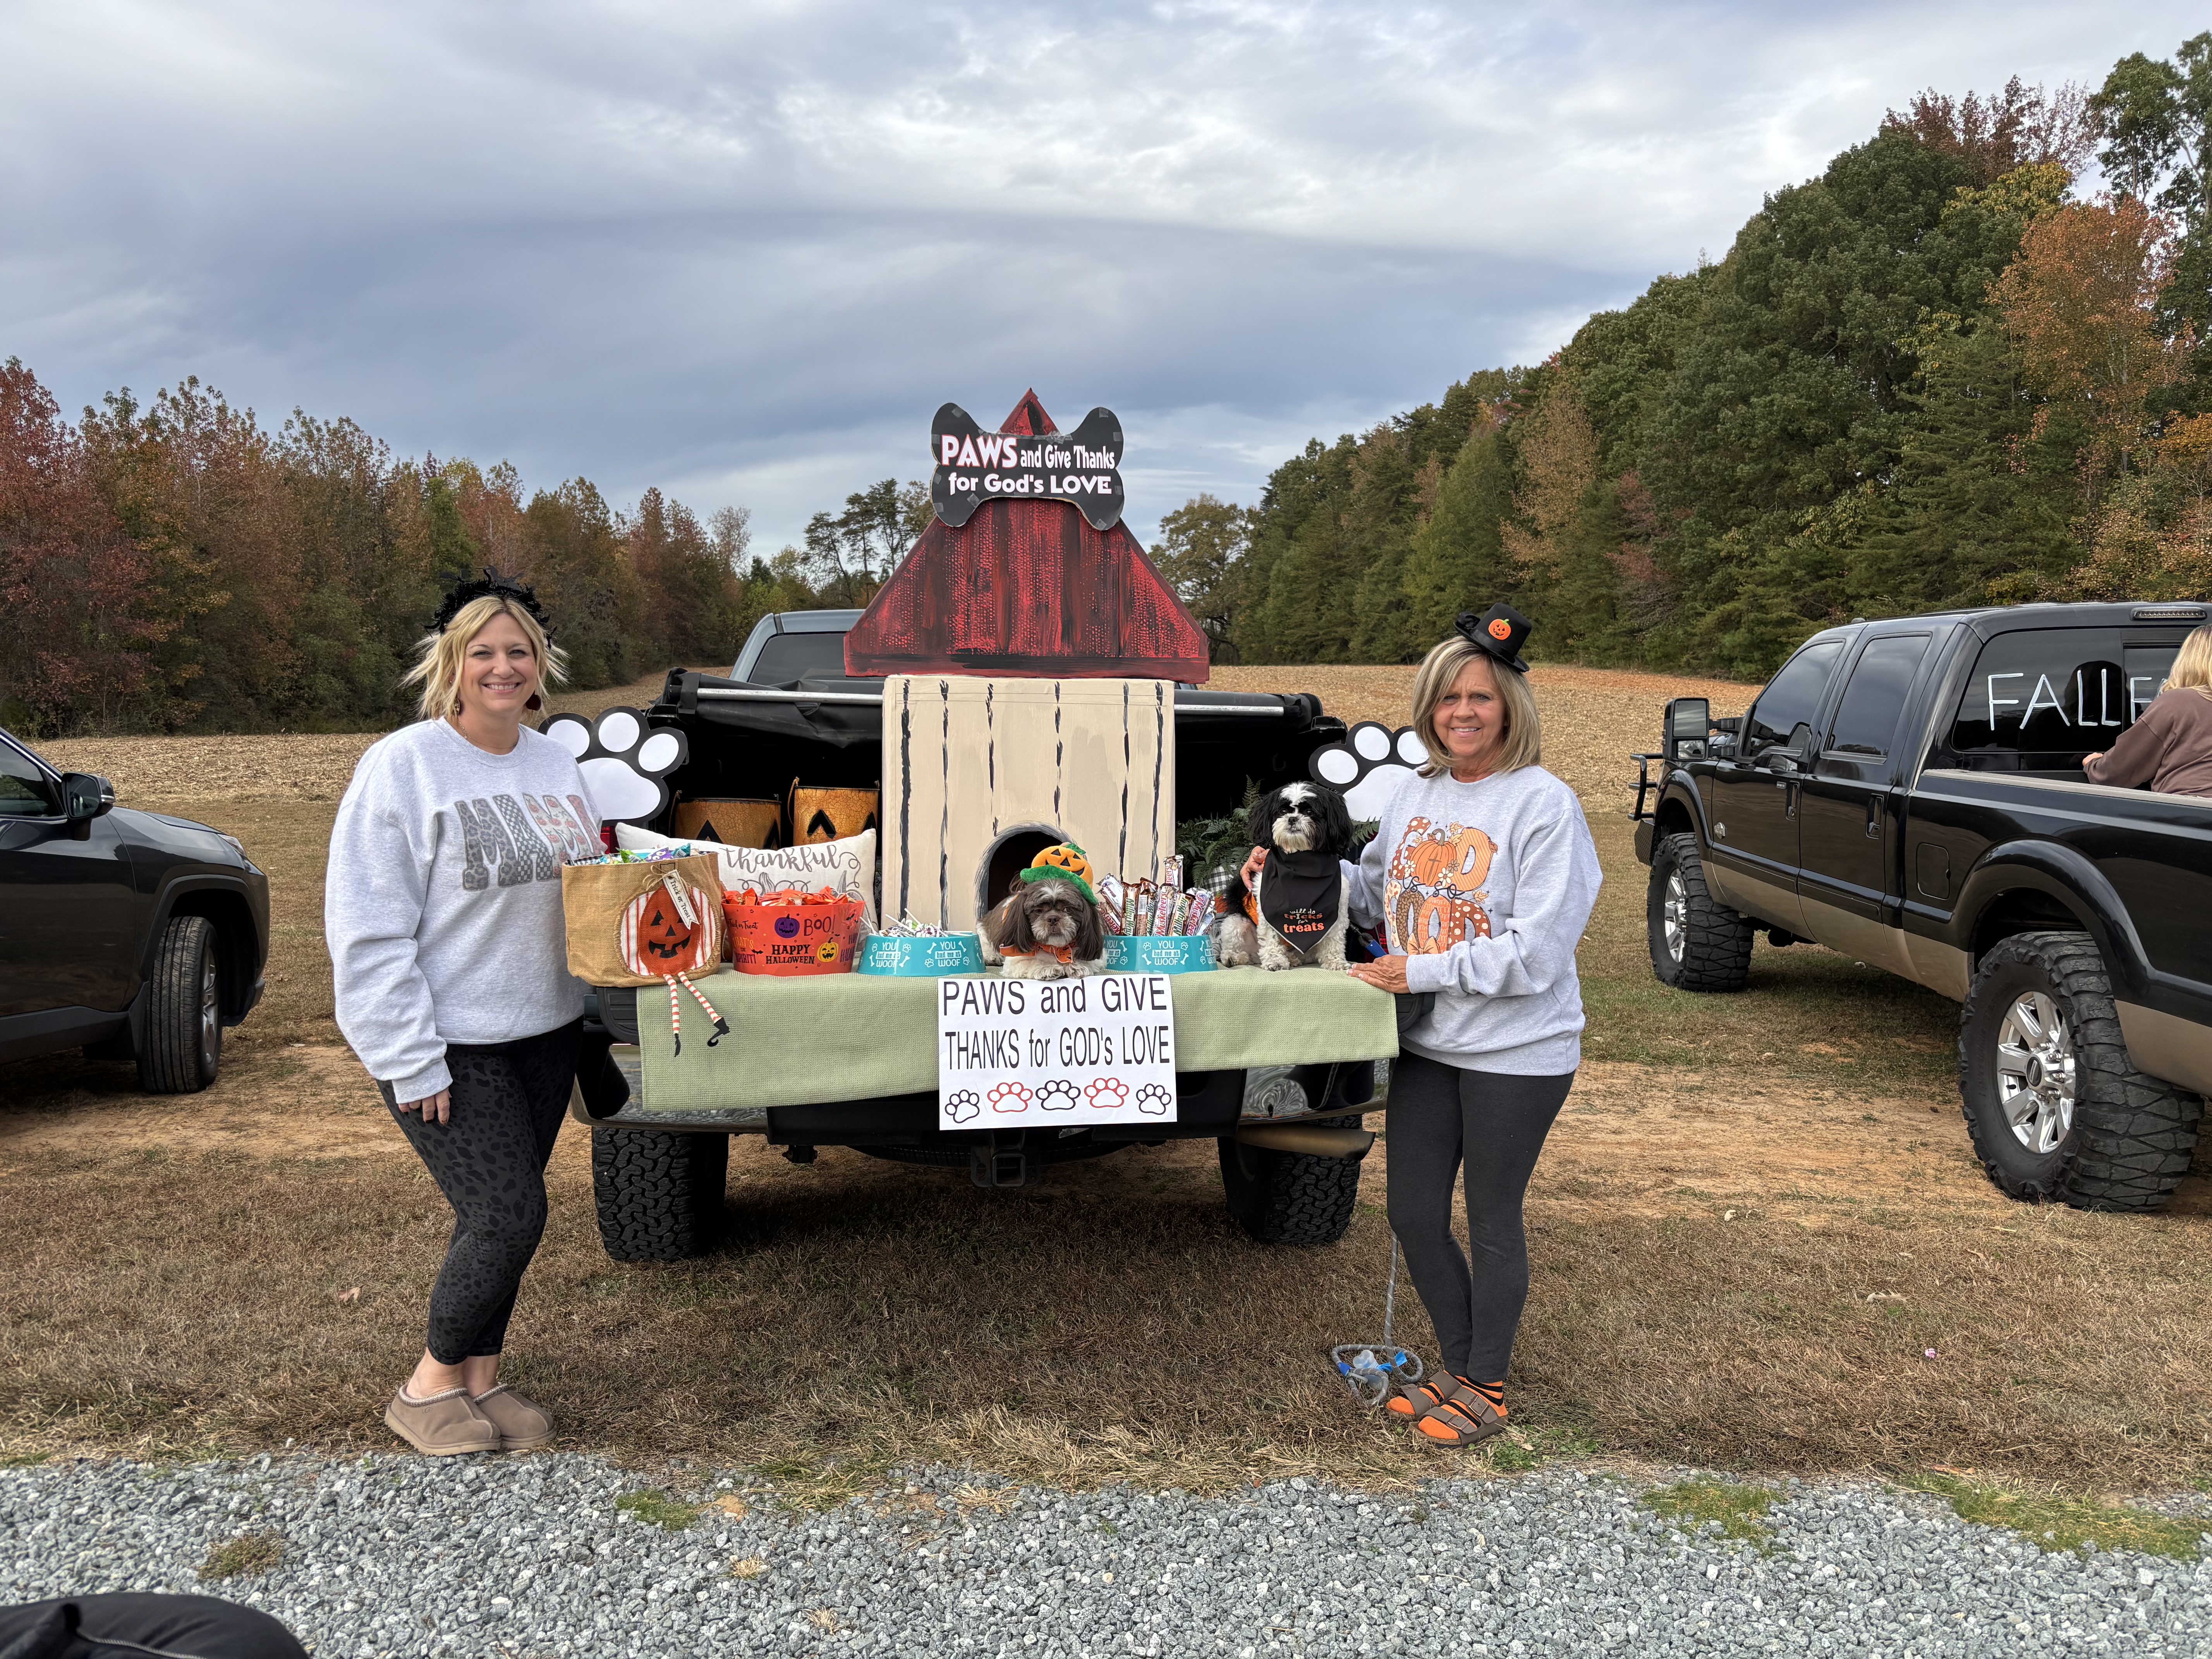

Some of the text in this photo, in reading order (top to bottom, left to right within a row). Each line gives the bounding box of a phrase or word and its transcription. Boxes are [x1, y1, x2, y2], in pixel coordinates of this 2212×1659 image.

[941, 434, 1115, 469] PAWS and Give Thanks
[948, 472, 1112, 495] for God's LOVE
[1988, 669, 2121, 731] FALL
[719, 845, 843, 873] thankful
[670, 879, 680, 896] Trick
[681, 903, 690, 918] Treat
[742, 920, 759, 929] Treat
[1283, 922, 1324, 933] treats
[771, 944, 811, 955] HAPPY
[882, 942, 896, 951] YOU
[940, 941, 955, 950] YOU
[1107, 940, 1118, 948] YOU
[1158, 941, 1174, 949] YOU
[766, 955, 815, 964] HALLOWEEN
[938, 959, 960, 967] WOOF
[944, 977, 1167, 1015] PAWS and GIVE
[945, 1026, 1170, 1070] THANKS for GOD's LOVE
